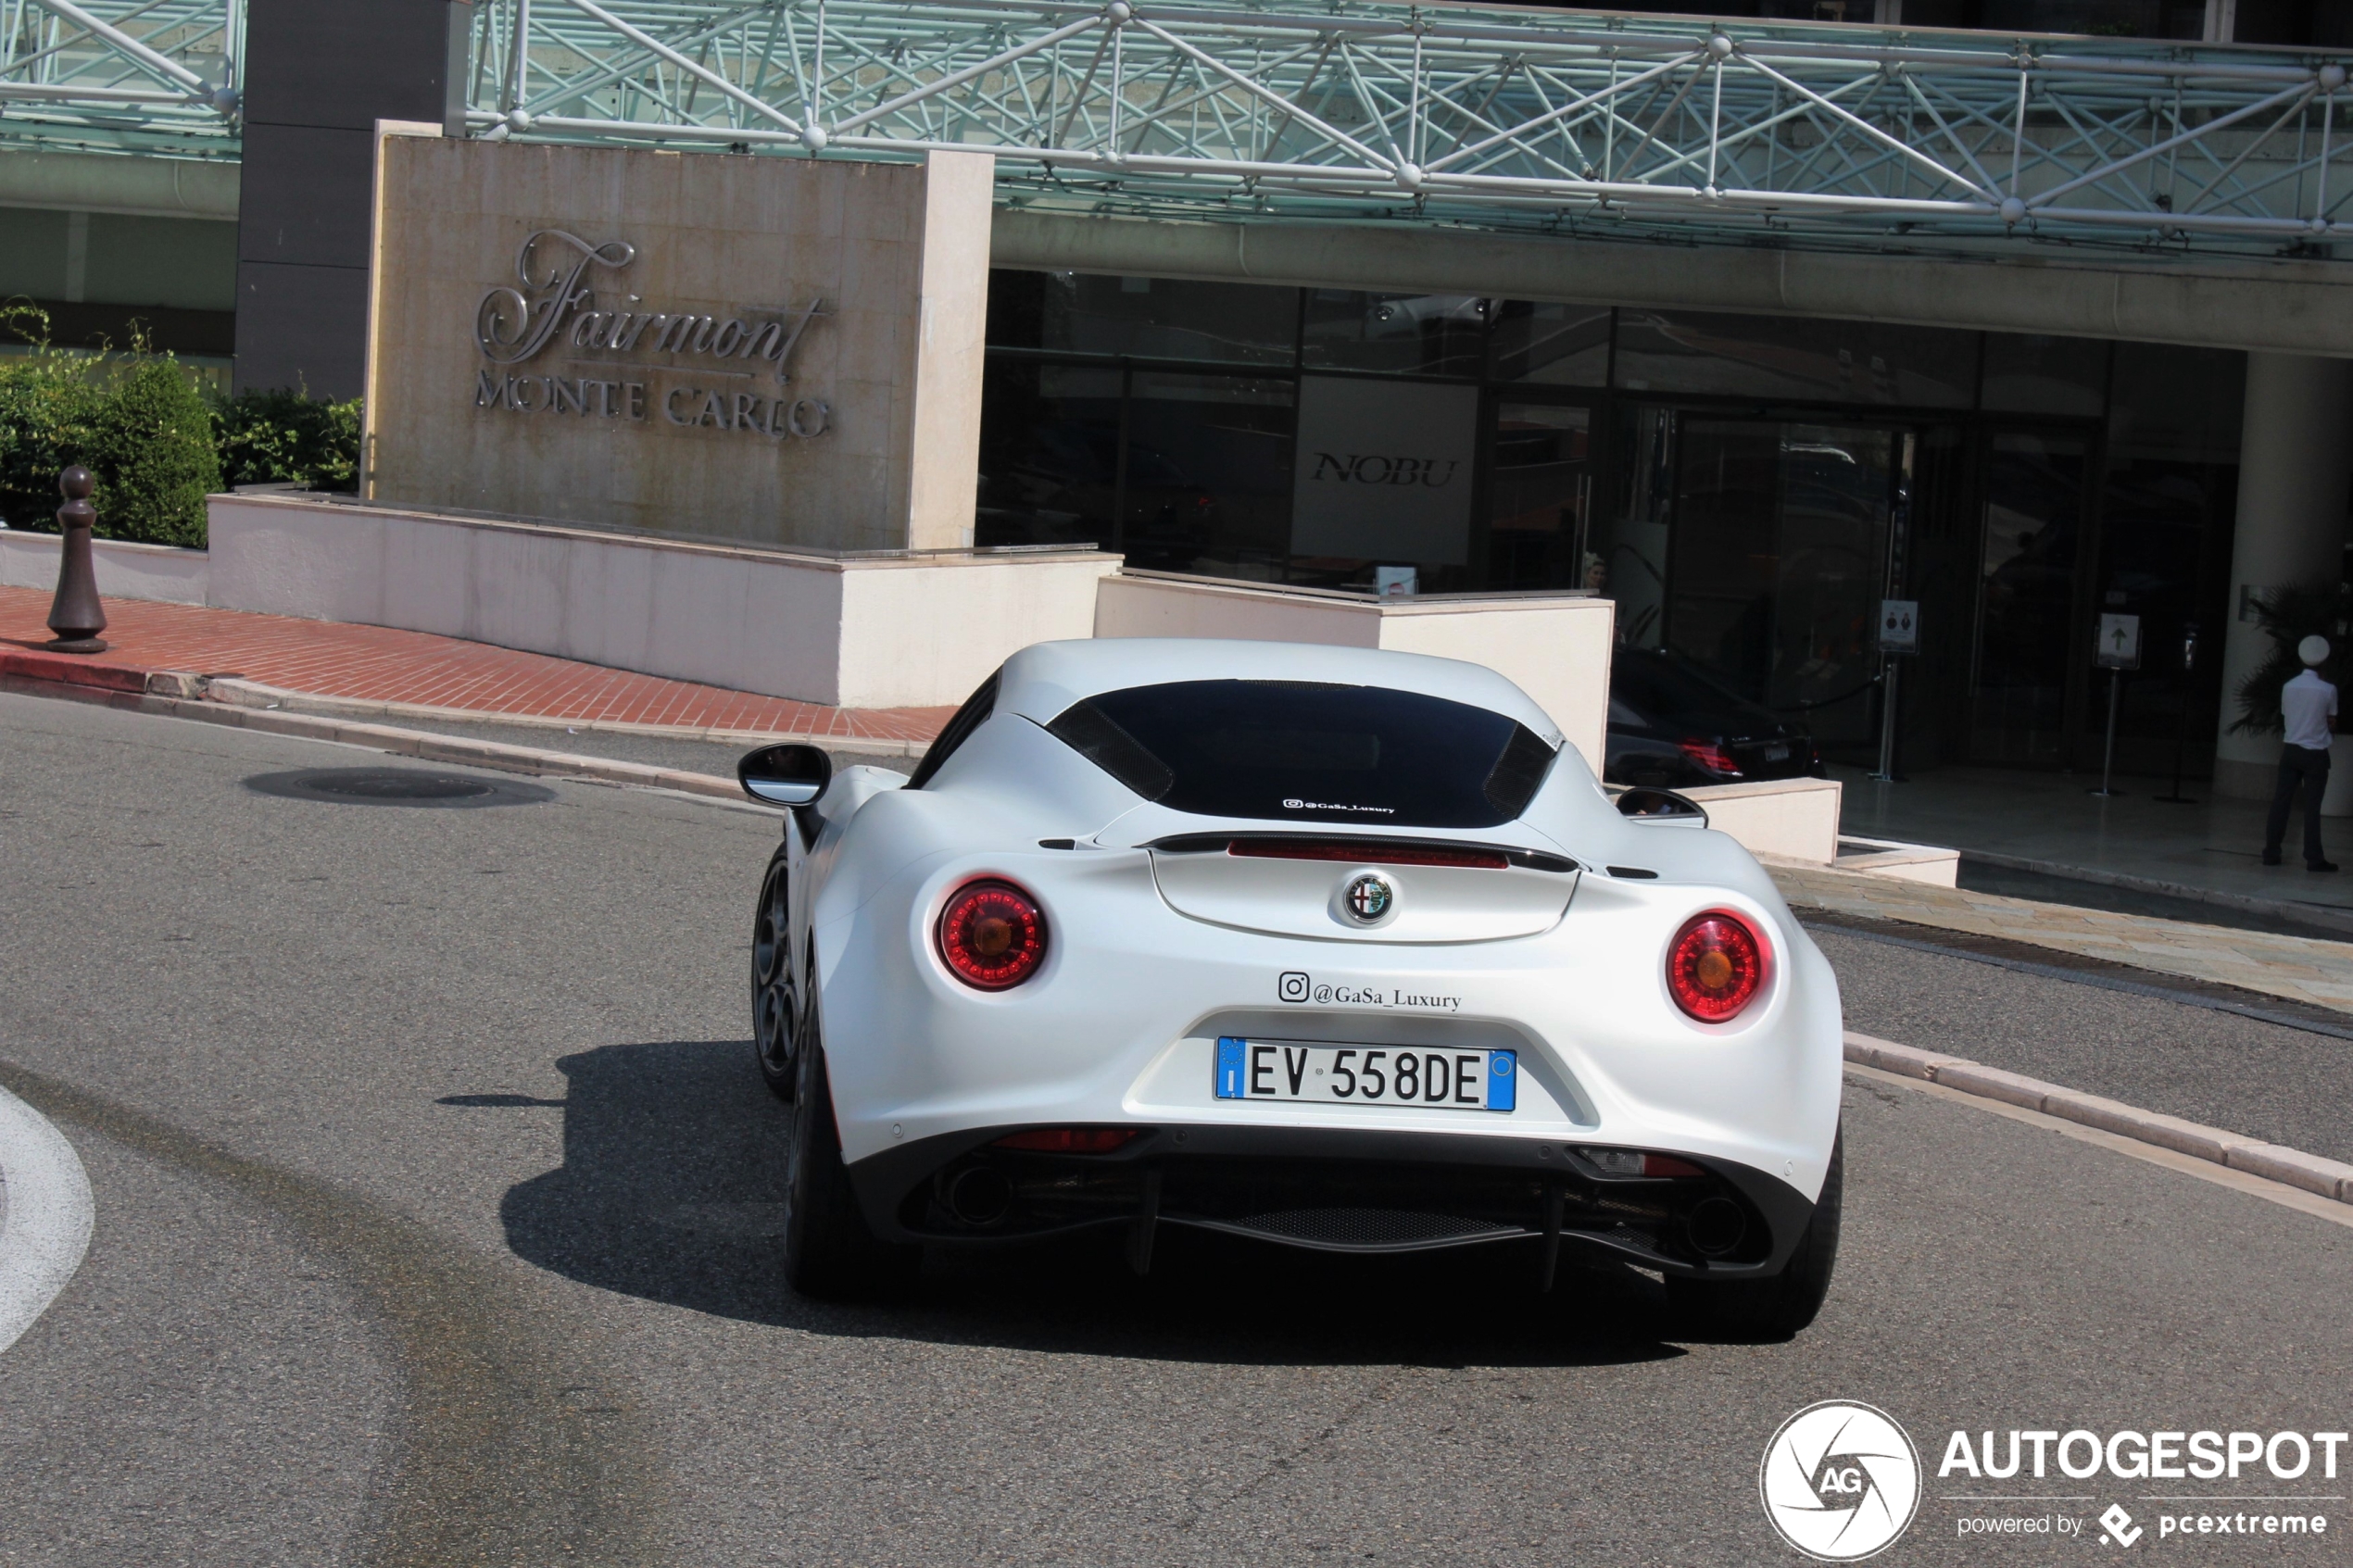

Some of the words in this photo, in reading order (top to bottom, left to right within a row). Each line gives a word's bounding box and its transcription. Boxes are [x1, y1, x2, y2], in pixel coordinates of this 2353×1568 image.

[476, 229, 833, 386] Fairmont
[474, 370, 646, 421] MONTE
[661, 387, 831, 439] CARLO
[1310, 452, 1460, 487] NOBU
[1314, 984, 1462, 1011] @GaSa_Luxury
[1251, 1046, 1308, 1096] EV
[1331, 1049, 1481, 1104] 558DE
